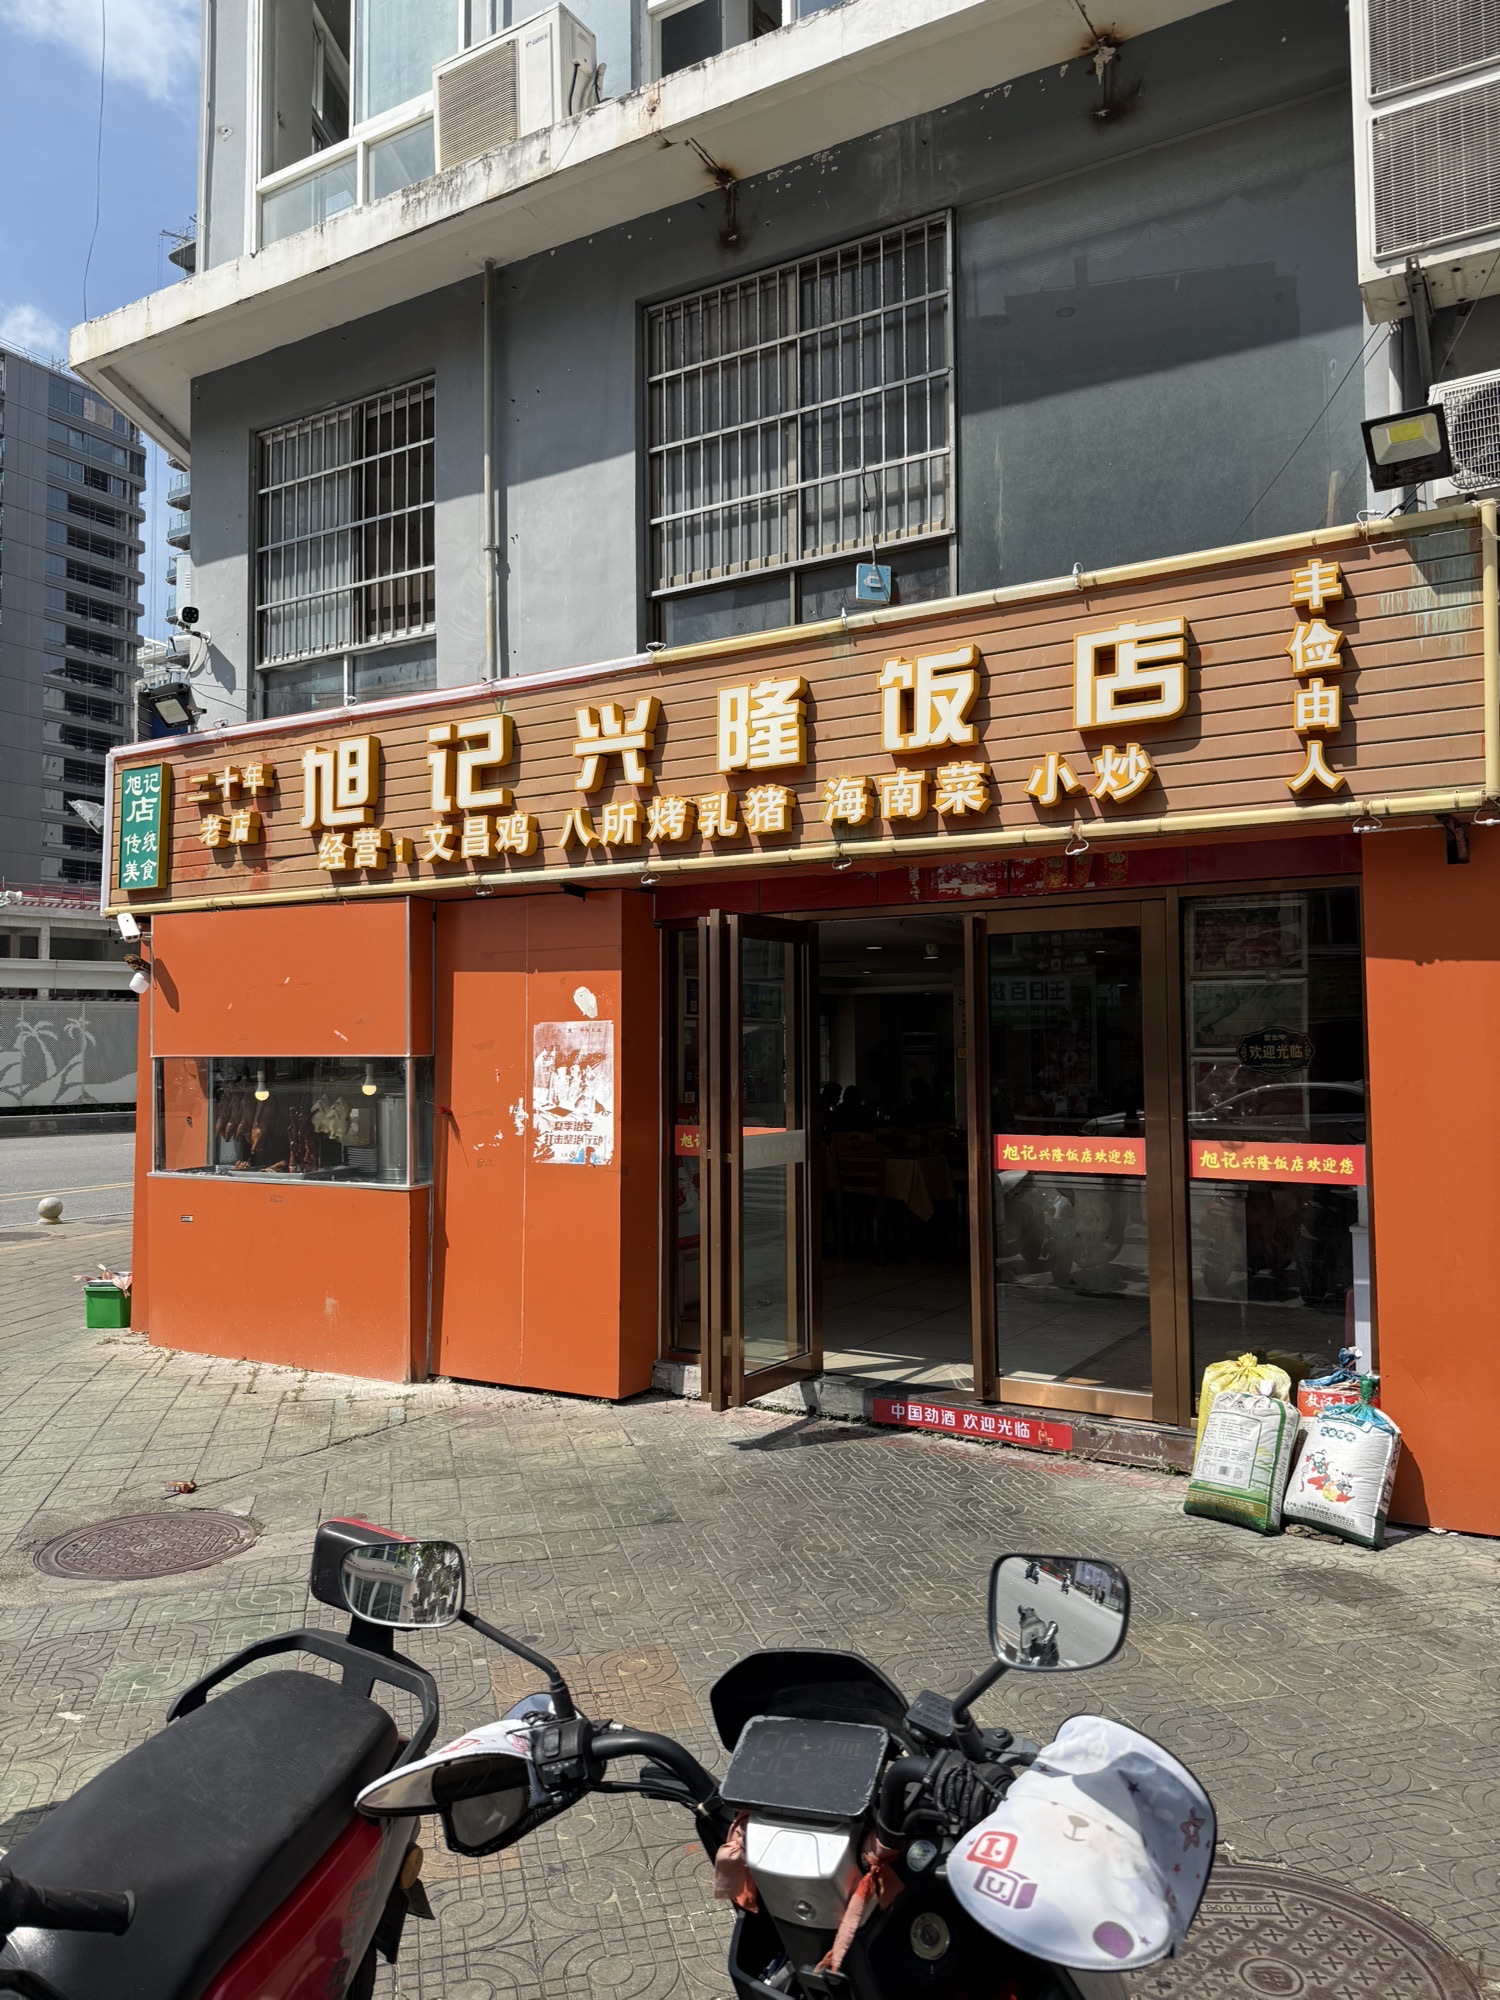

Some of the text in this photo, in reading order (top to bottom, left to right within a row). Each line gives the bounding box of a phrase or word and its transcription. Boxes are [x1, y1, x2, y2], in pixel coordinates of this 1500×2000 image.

[1285, 558, 1346, 793] 丰俭由人
[124, 771, 161, 796] 旭记
[186, 761, 274, 803] 二十年
[125, 796, 159, 823] 店
[556, 785, 796, 850] 八所烤乳猪
[822, 761, 992, 827] 海南菜
[1023, 743, 1155, 808] 小炒
[199, 809, 260, 848] 老店
[123, 829, 158, 856] 传统
[122, 858, 158, 883] 美食
[1248, 1044, 1303, 1060] 欢迎光临
[1002, 1143, 1137, 1165] 旭记兴隆饭店欢迎您
[1200, 1150, 1355, 1175] 旭记兴隆饭店欢迎您
[891, 1403, 1031, 1438] 中国劲酒 欢迎光临
